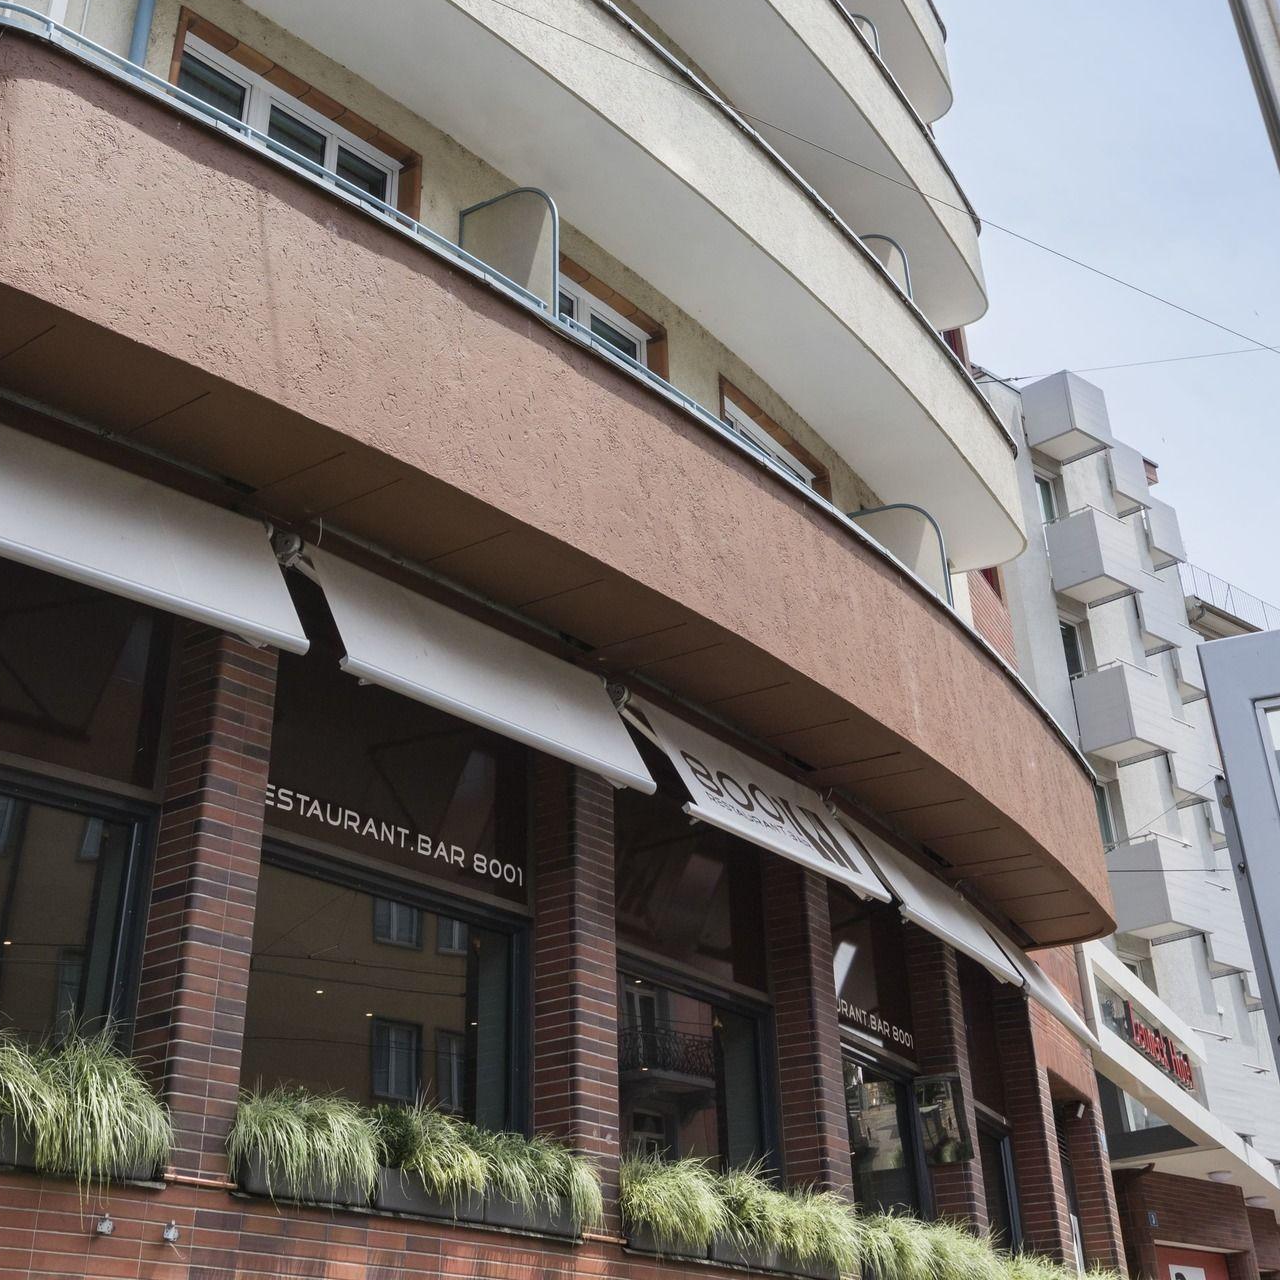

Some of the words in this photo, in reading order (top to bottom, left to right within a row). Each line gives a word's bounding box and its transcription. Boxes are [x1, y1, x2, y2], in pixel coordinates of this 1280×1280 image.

[265, 783, 465, 868] ESTAURANT.BAR
[473, 853, 523, 887] 8001
[892, 1025, 914, 1049] 8001
